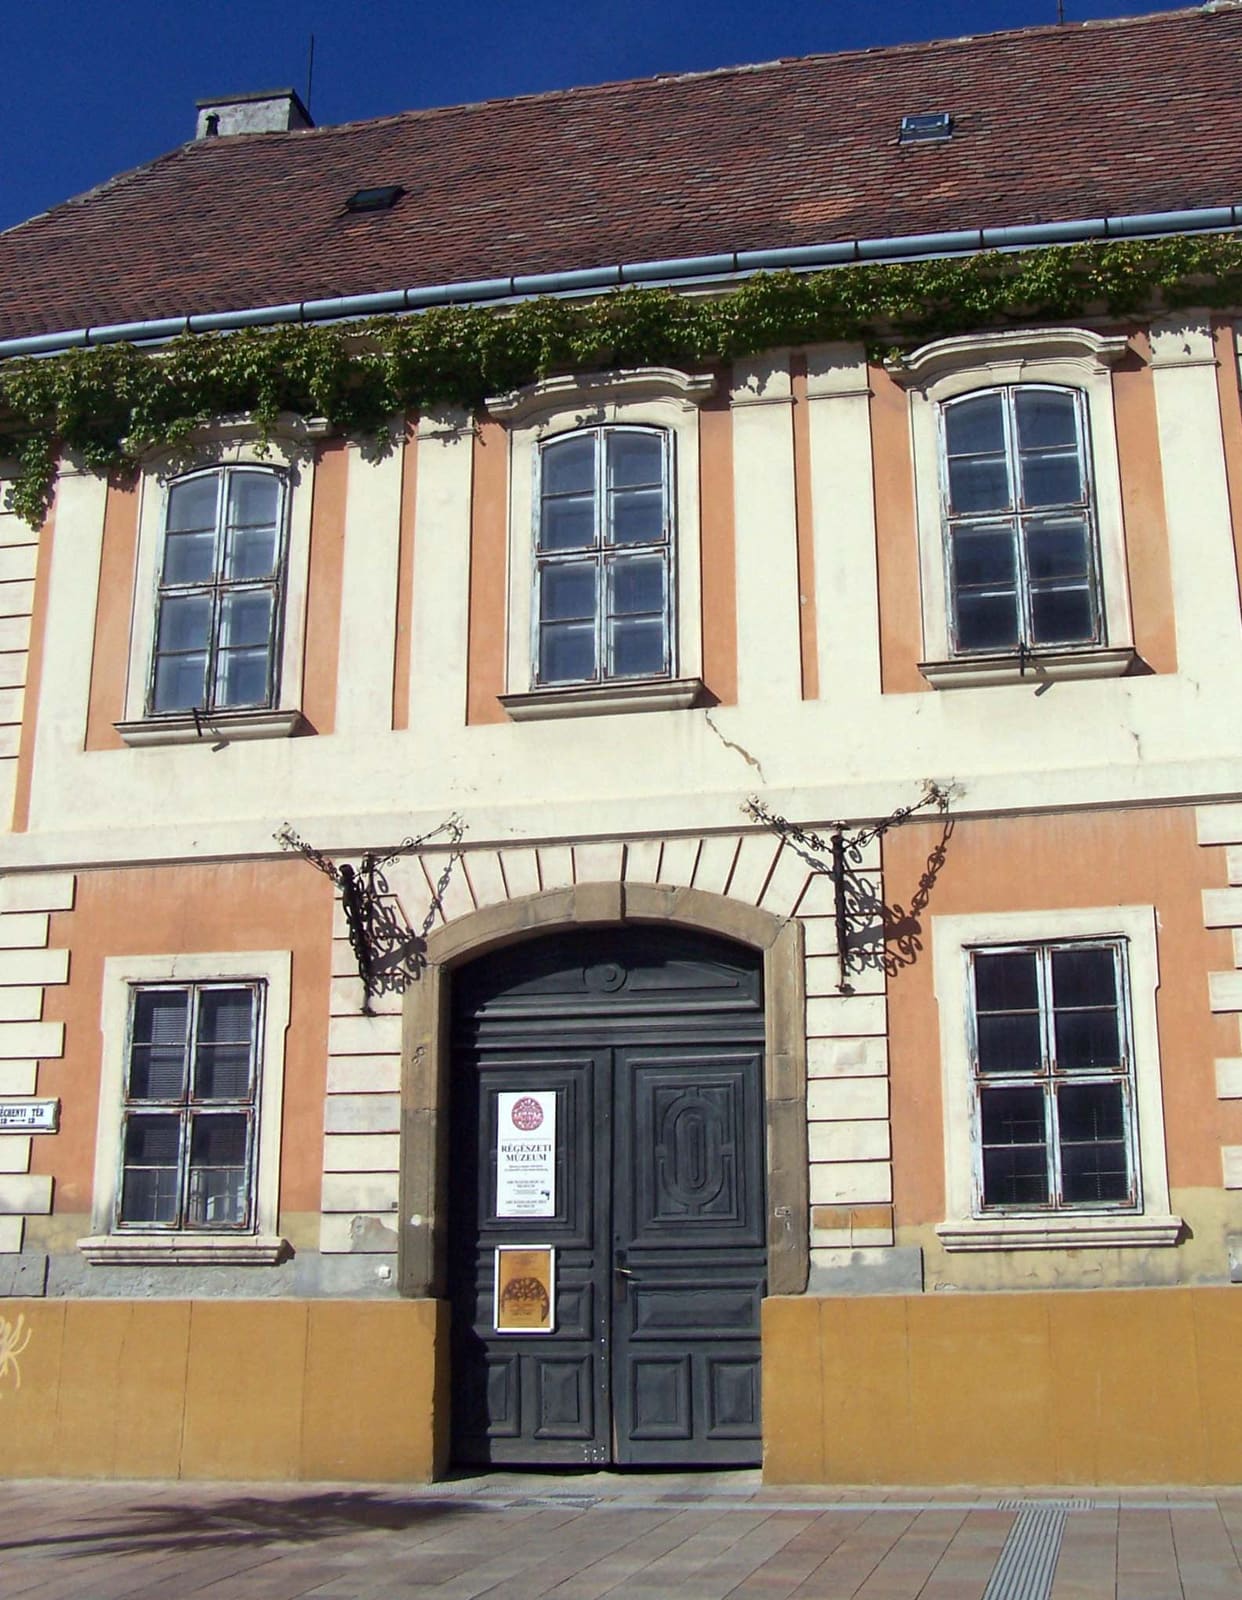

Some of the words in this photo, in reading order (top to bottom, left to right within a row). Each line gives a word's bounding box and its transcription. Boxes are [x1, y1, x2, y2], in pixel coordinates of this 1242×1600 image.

[32, 1104, 44, 1117] TÉR
[501, 1143, 552, 1153] RÉGÉSZETI
[506, 1152, 547, 1161] MÚZEUM
